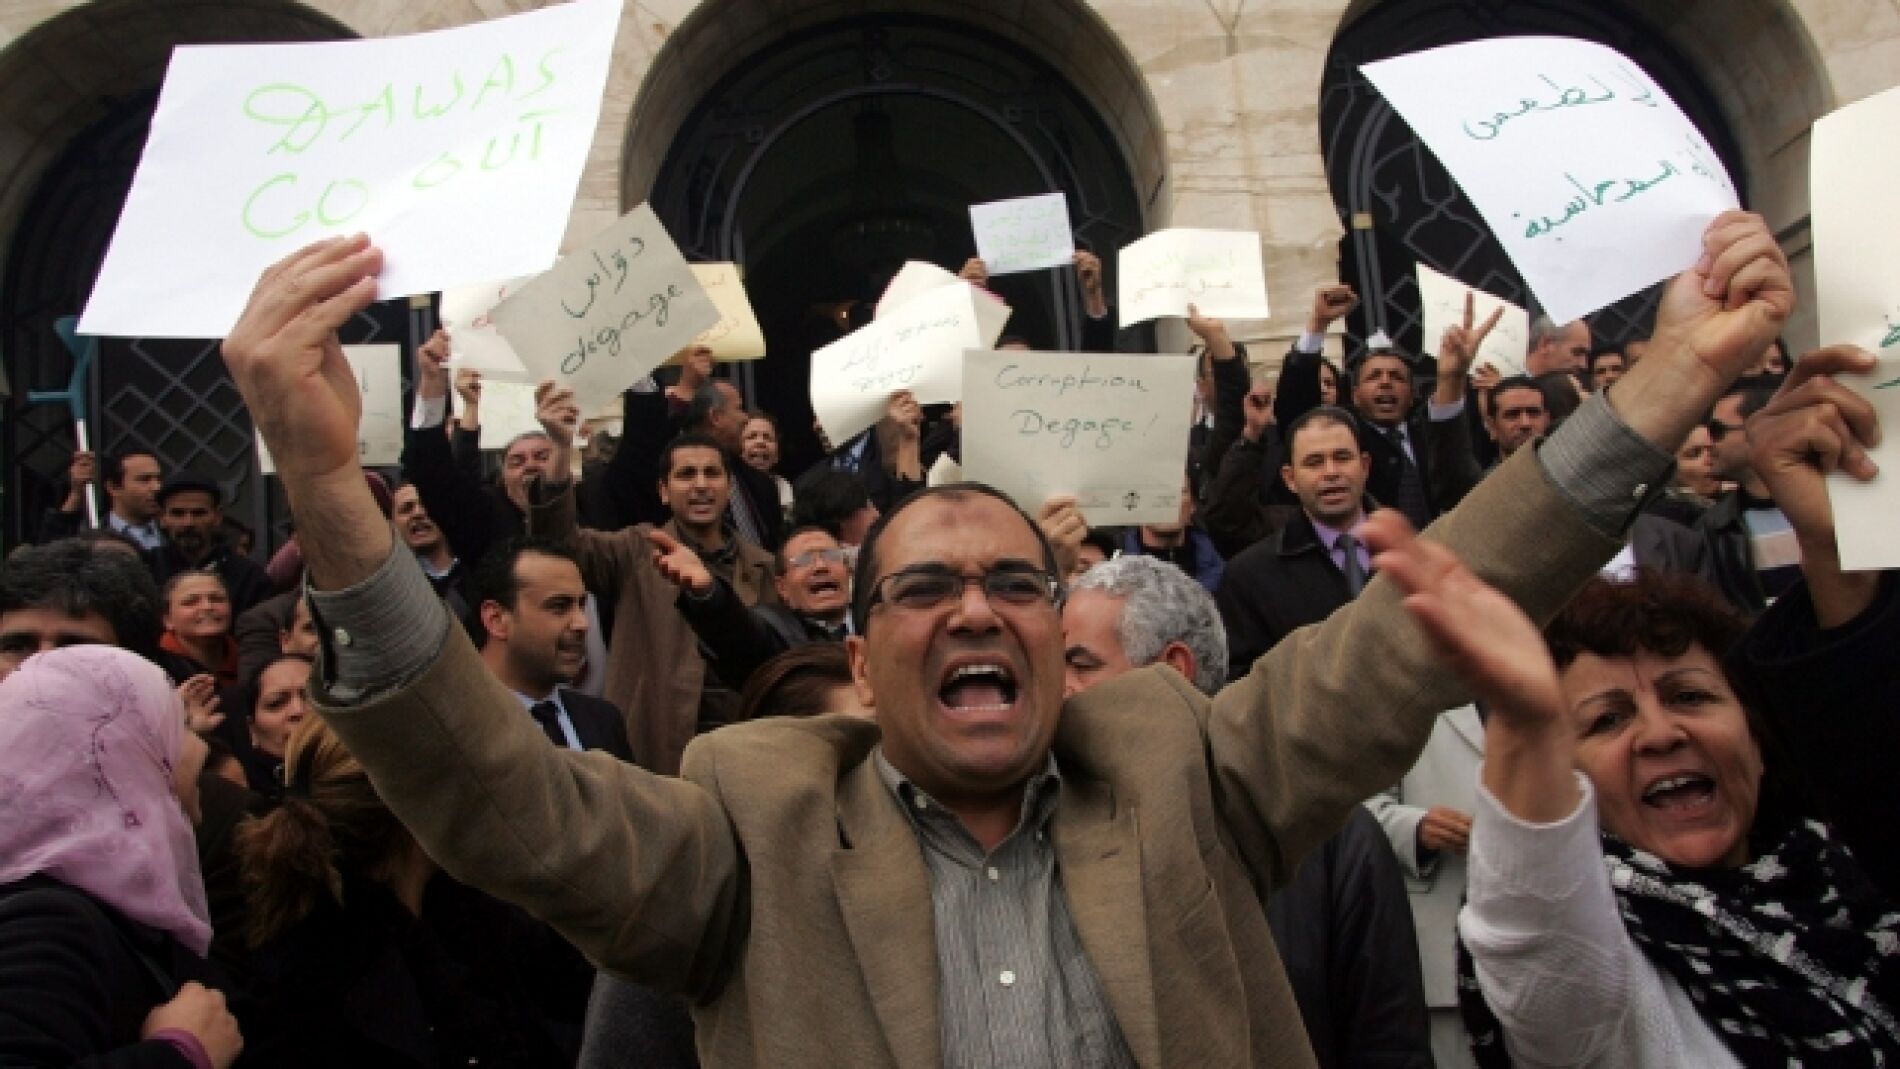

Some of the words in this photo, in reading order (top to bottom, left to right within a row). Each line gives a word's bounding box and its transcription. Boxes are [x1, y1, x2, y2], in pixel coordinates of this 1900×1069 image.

[243, 46, 566, 155] DAWAS
[242, 172, 370, 239] GO
[411, 105, 574, 188] OUT
[993, 363, 1150, 395] Corruption
